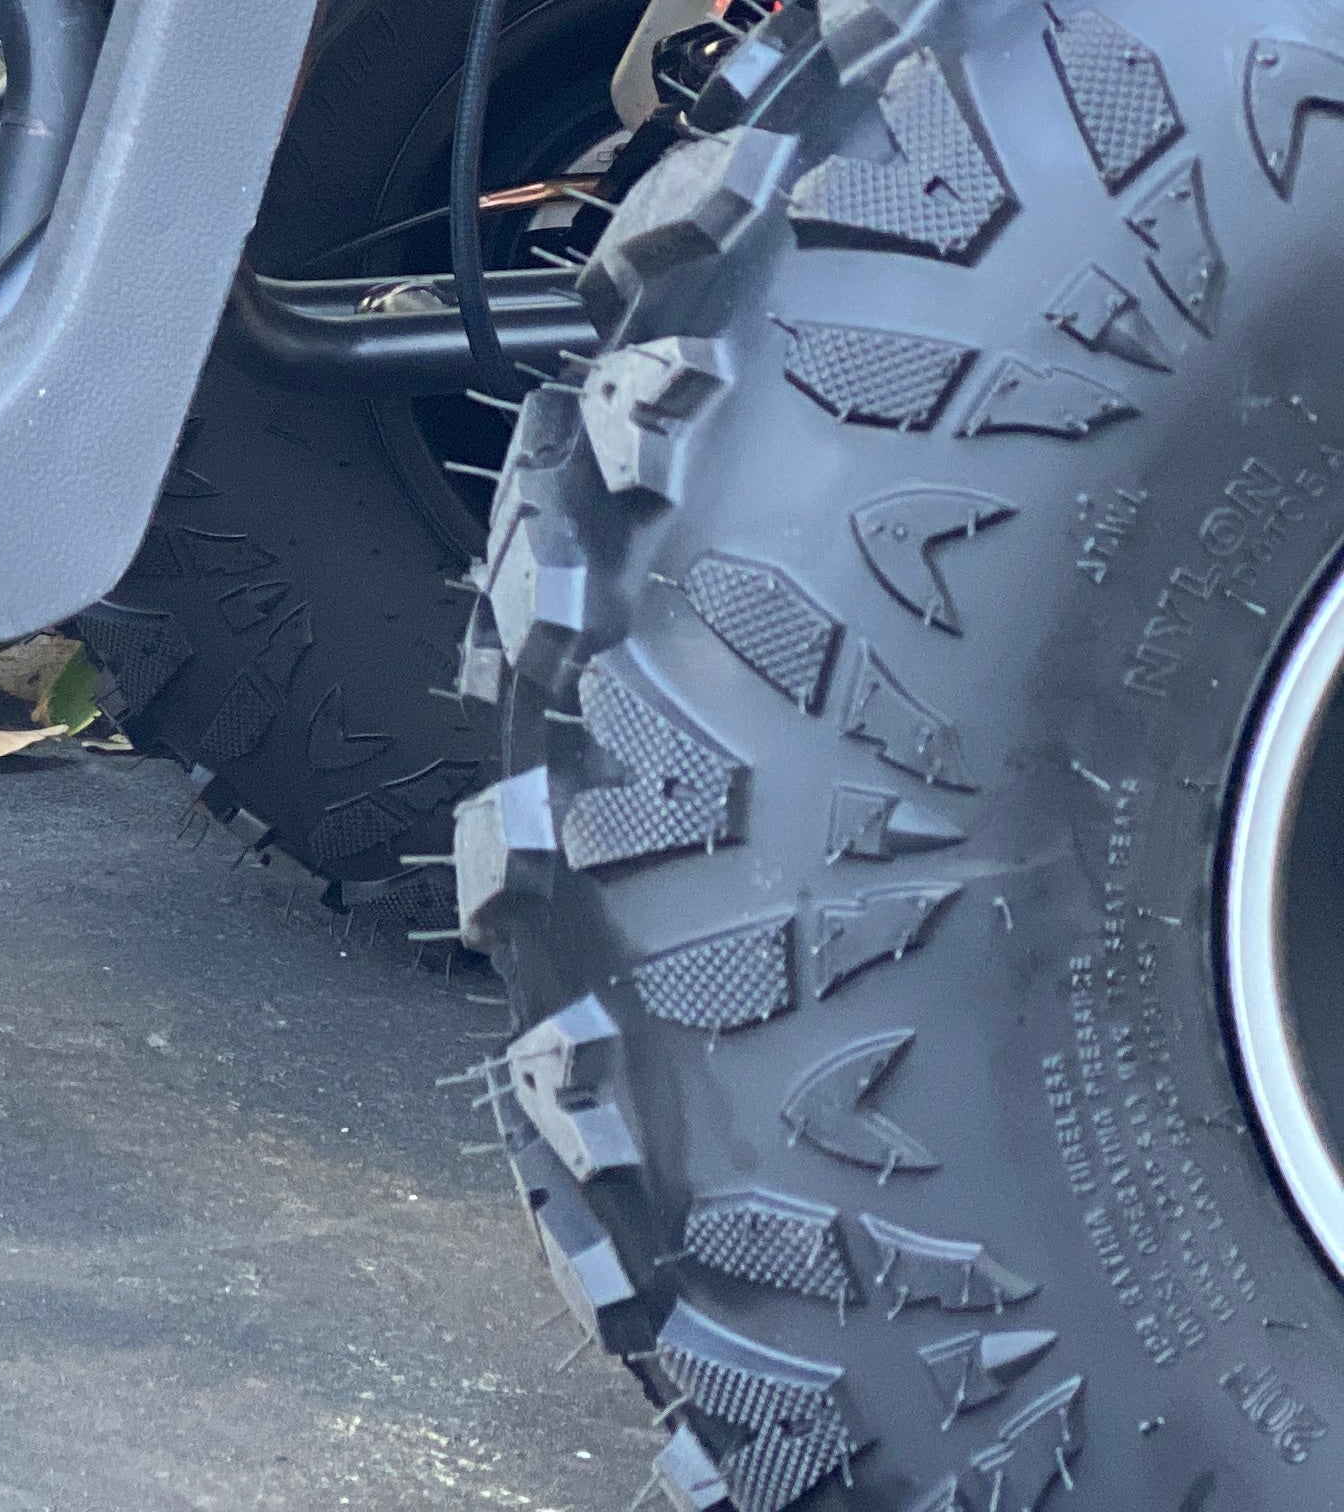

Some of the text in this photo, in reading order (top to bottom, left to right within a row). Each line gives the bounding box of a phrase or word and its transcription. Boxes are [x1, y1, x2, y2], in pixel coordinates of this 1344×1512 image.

[1124, 457, 1283, 696] NYLON
[1068, 954, 1107, 1098] PRESSURE
[1038, 1050, 1096, 1199] TUBELESS
